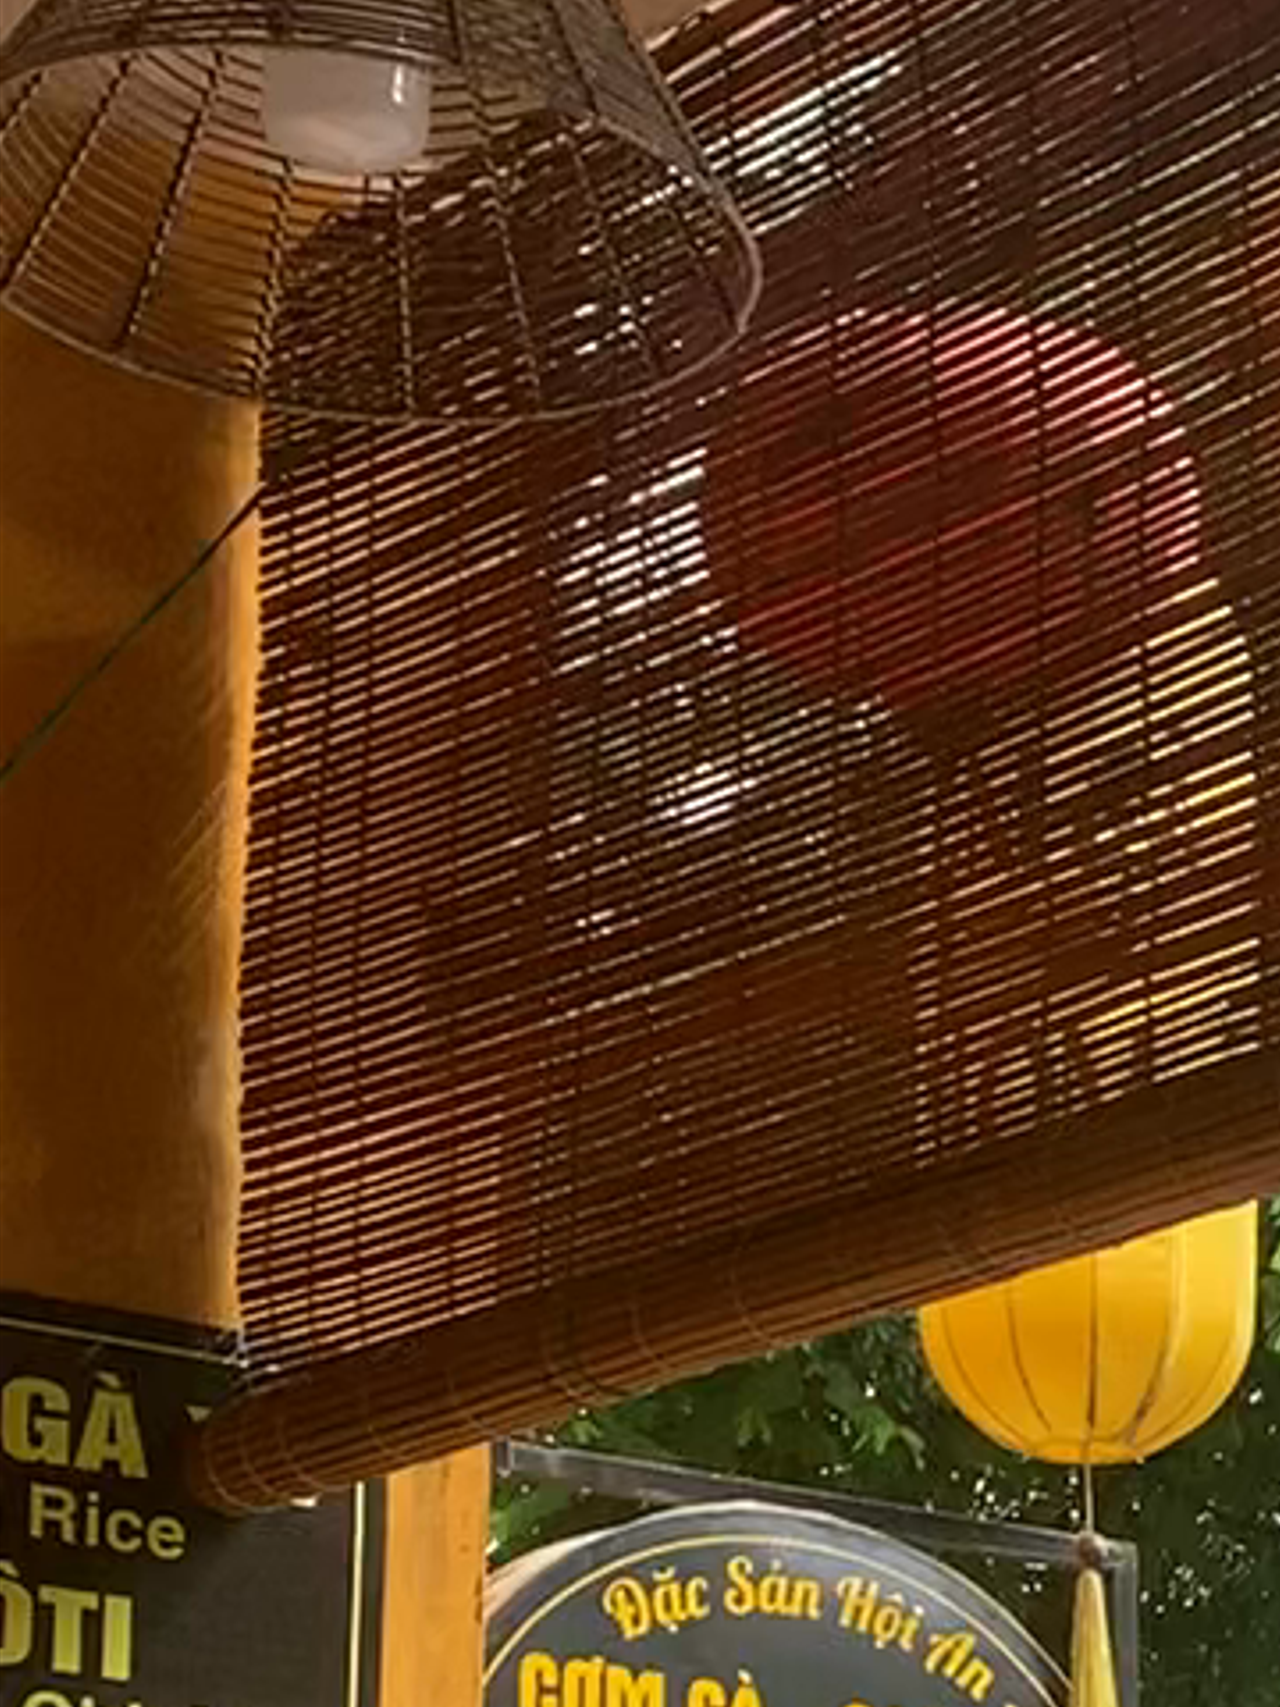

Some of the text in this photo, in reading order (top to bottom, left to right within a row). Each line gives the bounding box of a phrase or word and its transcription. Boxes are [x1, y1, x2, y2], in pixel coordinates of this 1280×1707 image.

[2, 1370, 148, 1479] GÀ
[29, 1481, 186, 1560] Rice
[602, 1565, 712, 1641] Đặc
[922, 1630, 996, 1701] An
